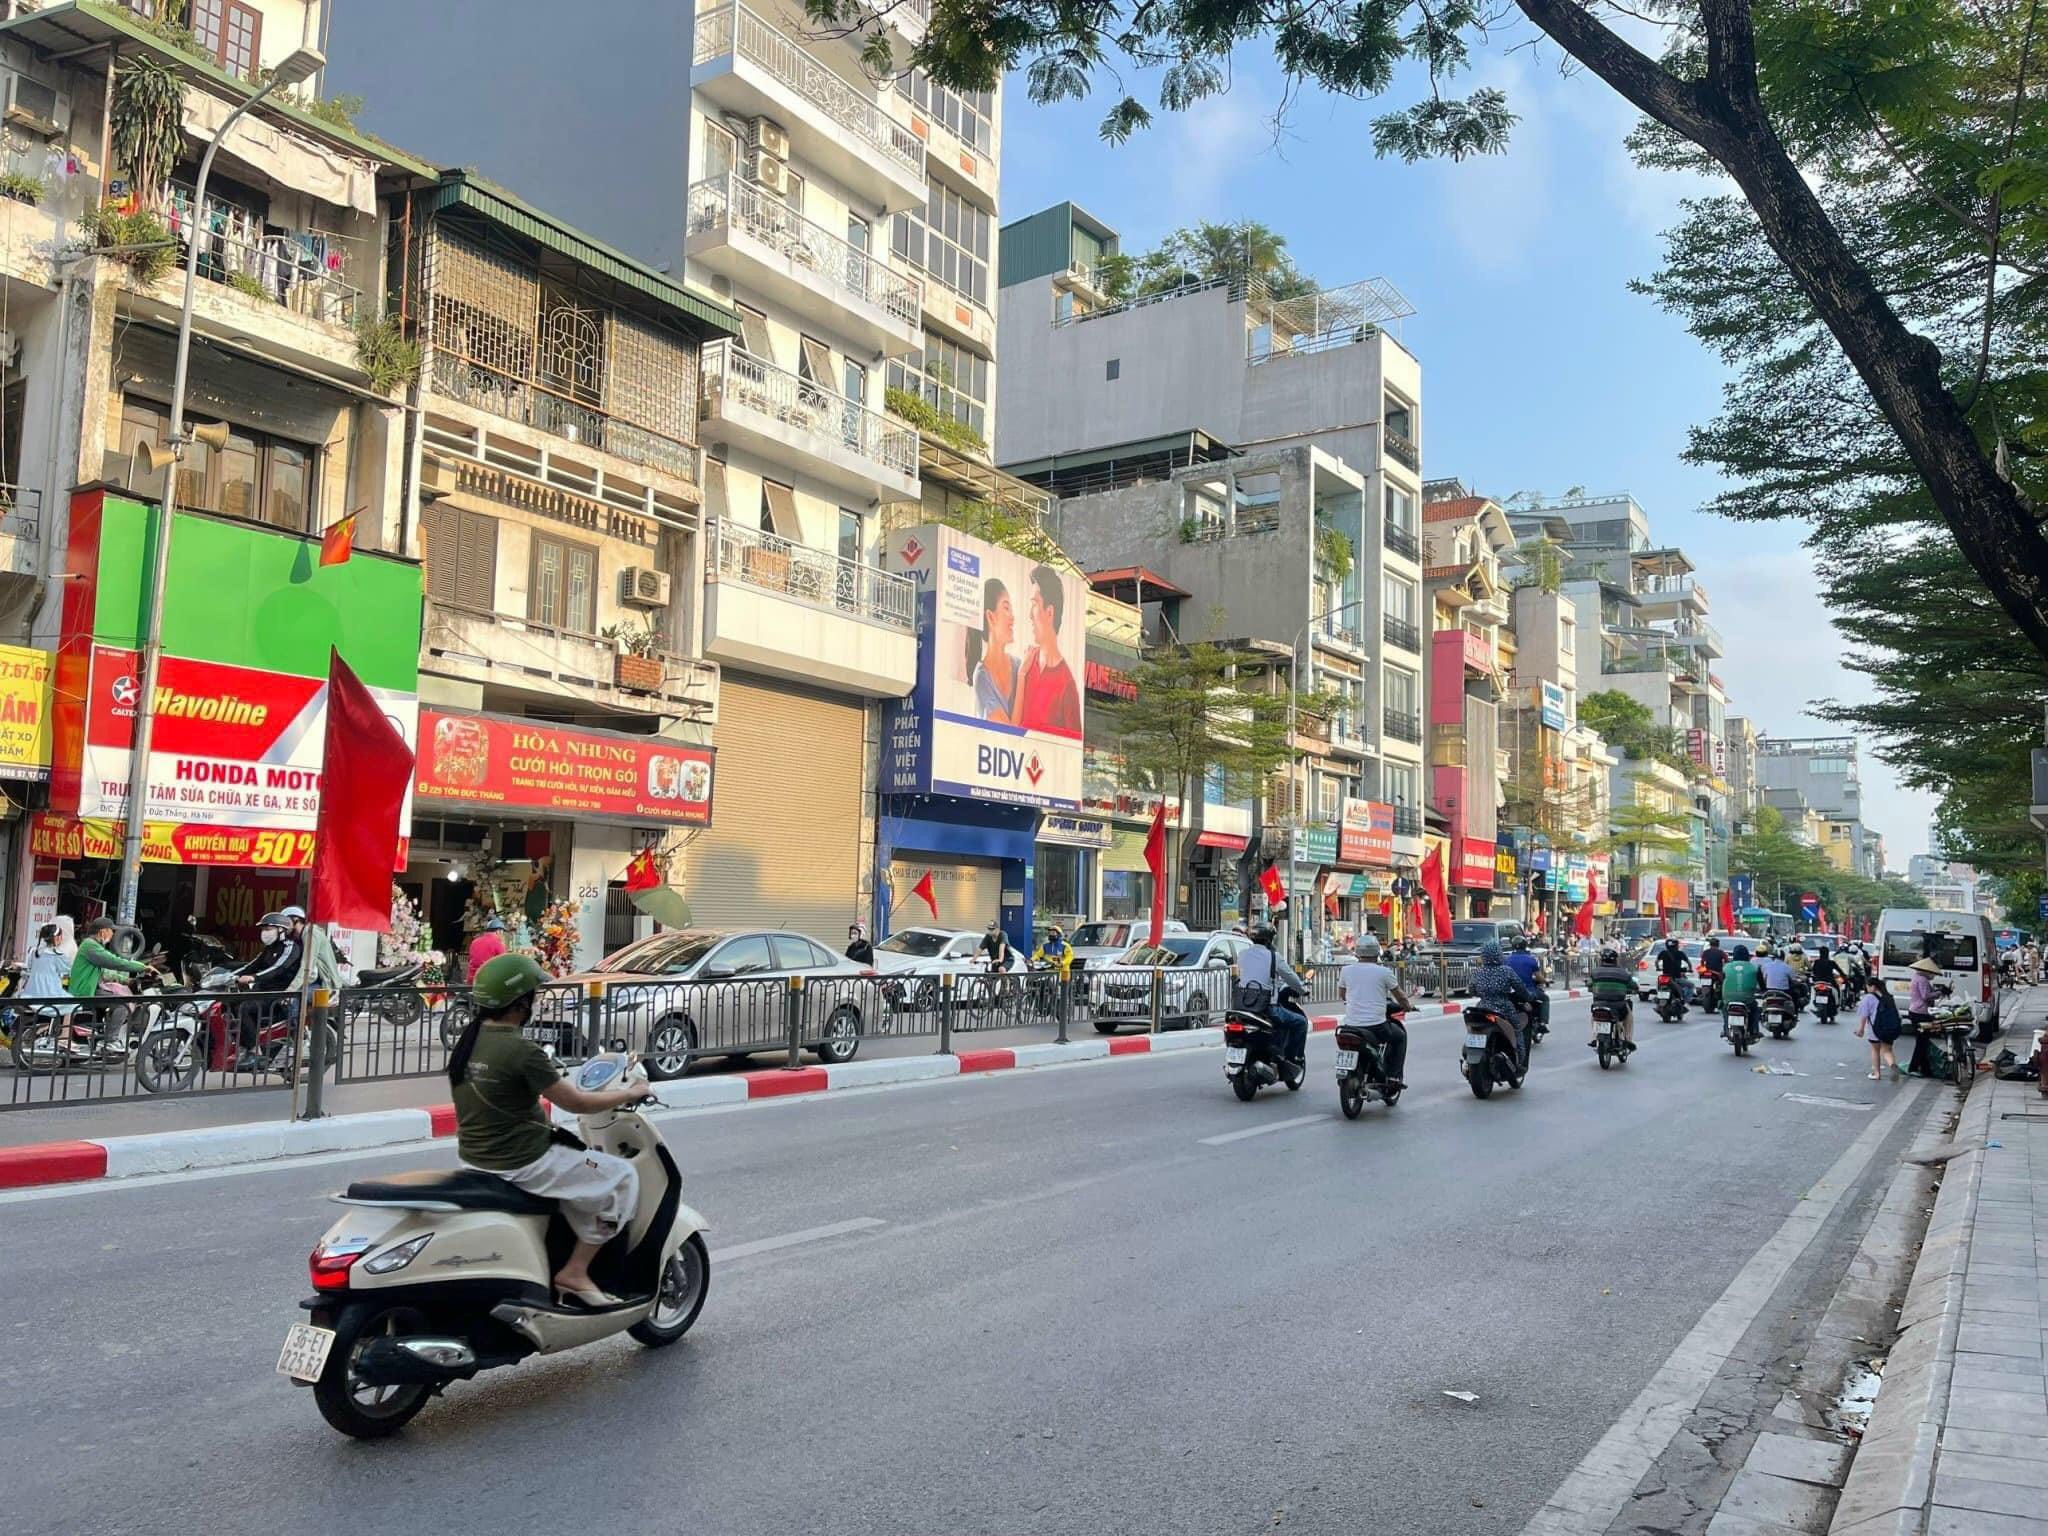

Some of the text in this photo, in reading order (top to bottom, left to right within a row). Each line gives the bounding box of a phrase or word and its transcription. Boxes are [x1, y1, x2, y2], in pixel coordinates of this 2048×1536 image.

[153, 686, 267, 727] Havoline
[895, 713, 920, 730] PHÁT
[512, 731, 637, 764] HÒA NHUNG
[977, 743, 1025, 780] BIDV
[176, 759, 257, 788] HONDA
[510, 756, 638, 784] CƯỚI HỎI TRỌN GÓI
[893, 772, 917, 787] NAM
[101, 781, 316, 811] TRU TÂM SỬA CHỮA XE GA, XE SỐ
[185, 832, 227, 852] KHUYẾN
[579, 886, 598, 898] 225
